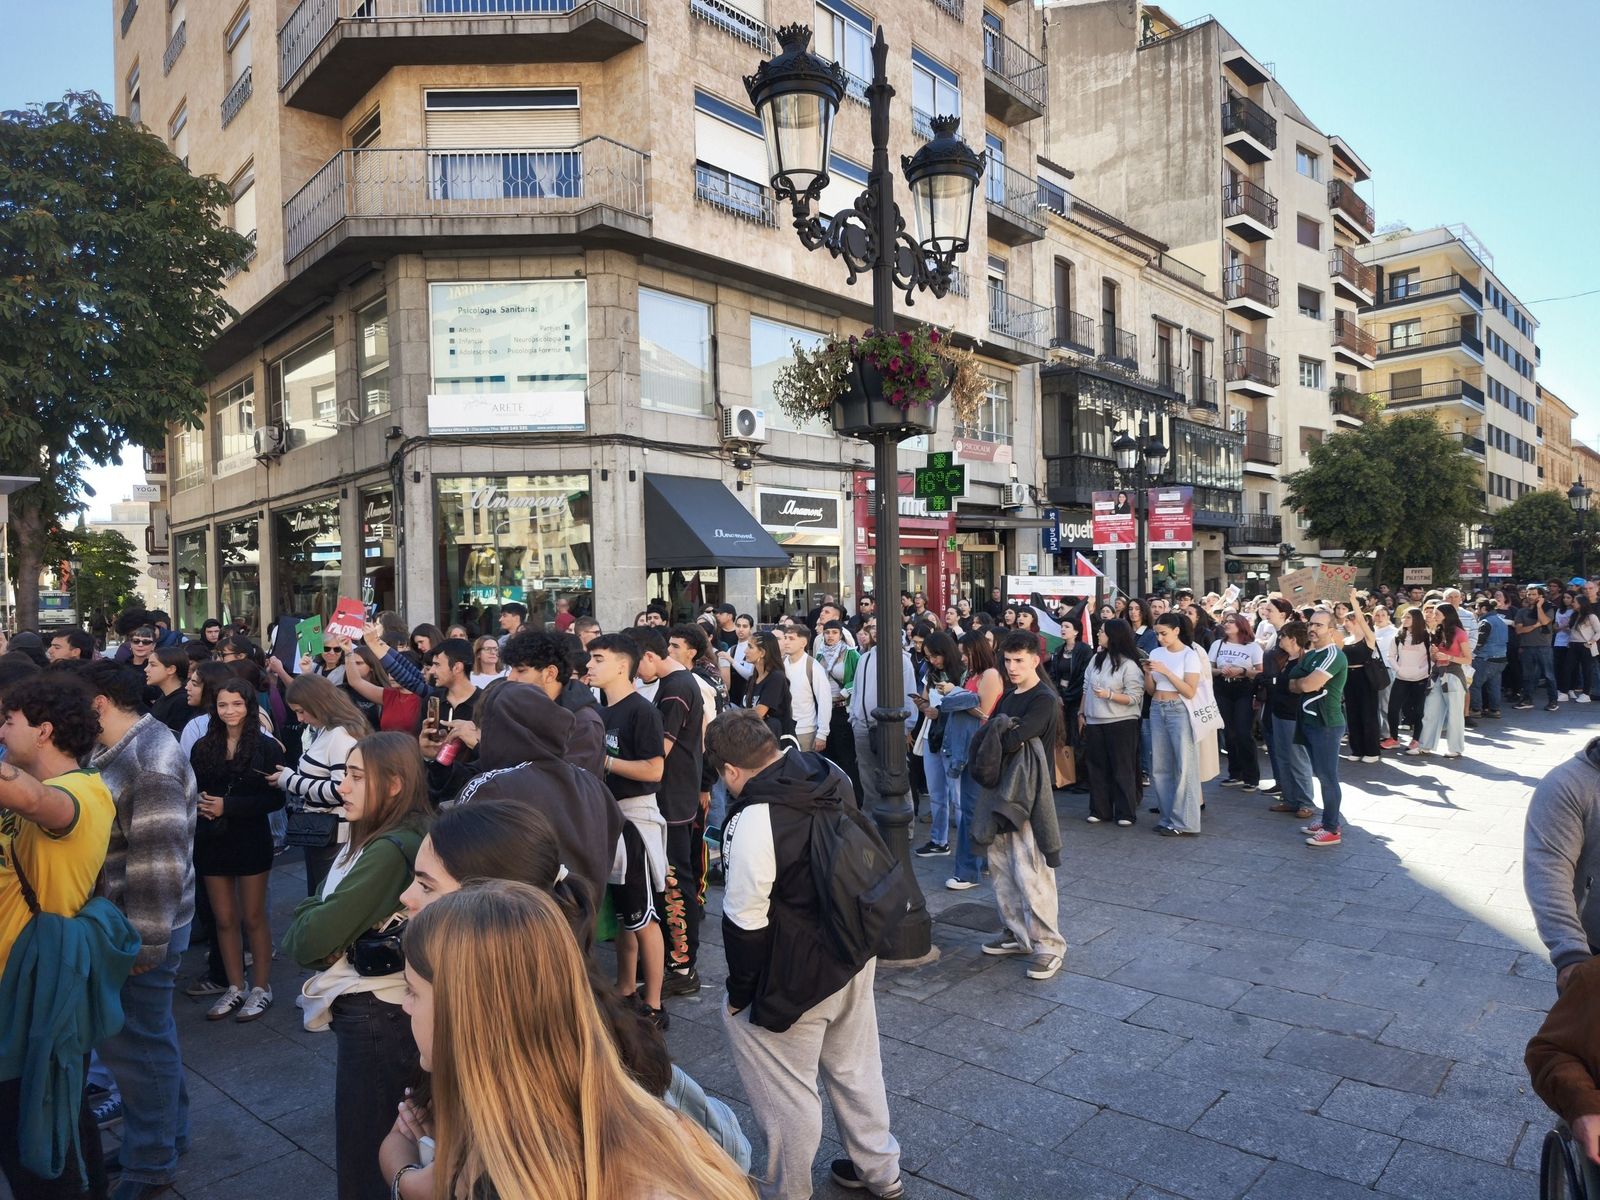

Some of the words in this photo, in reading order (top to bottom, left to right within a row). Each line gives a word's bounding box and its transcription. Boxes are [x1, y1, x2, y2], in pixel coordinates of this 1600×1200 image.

[461, 485, 567, 521] Anamont
[778, 499, 823, 522] Anamont
[713, 528, 756, 543] Anamont
